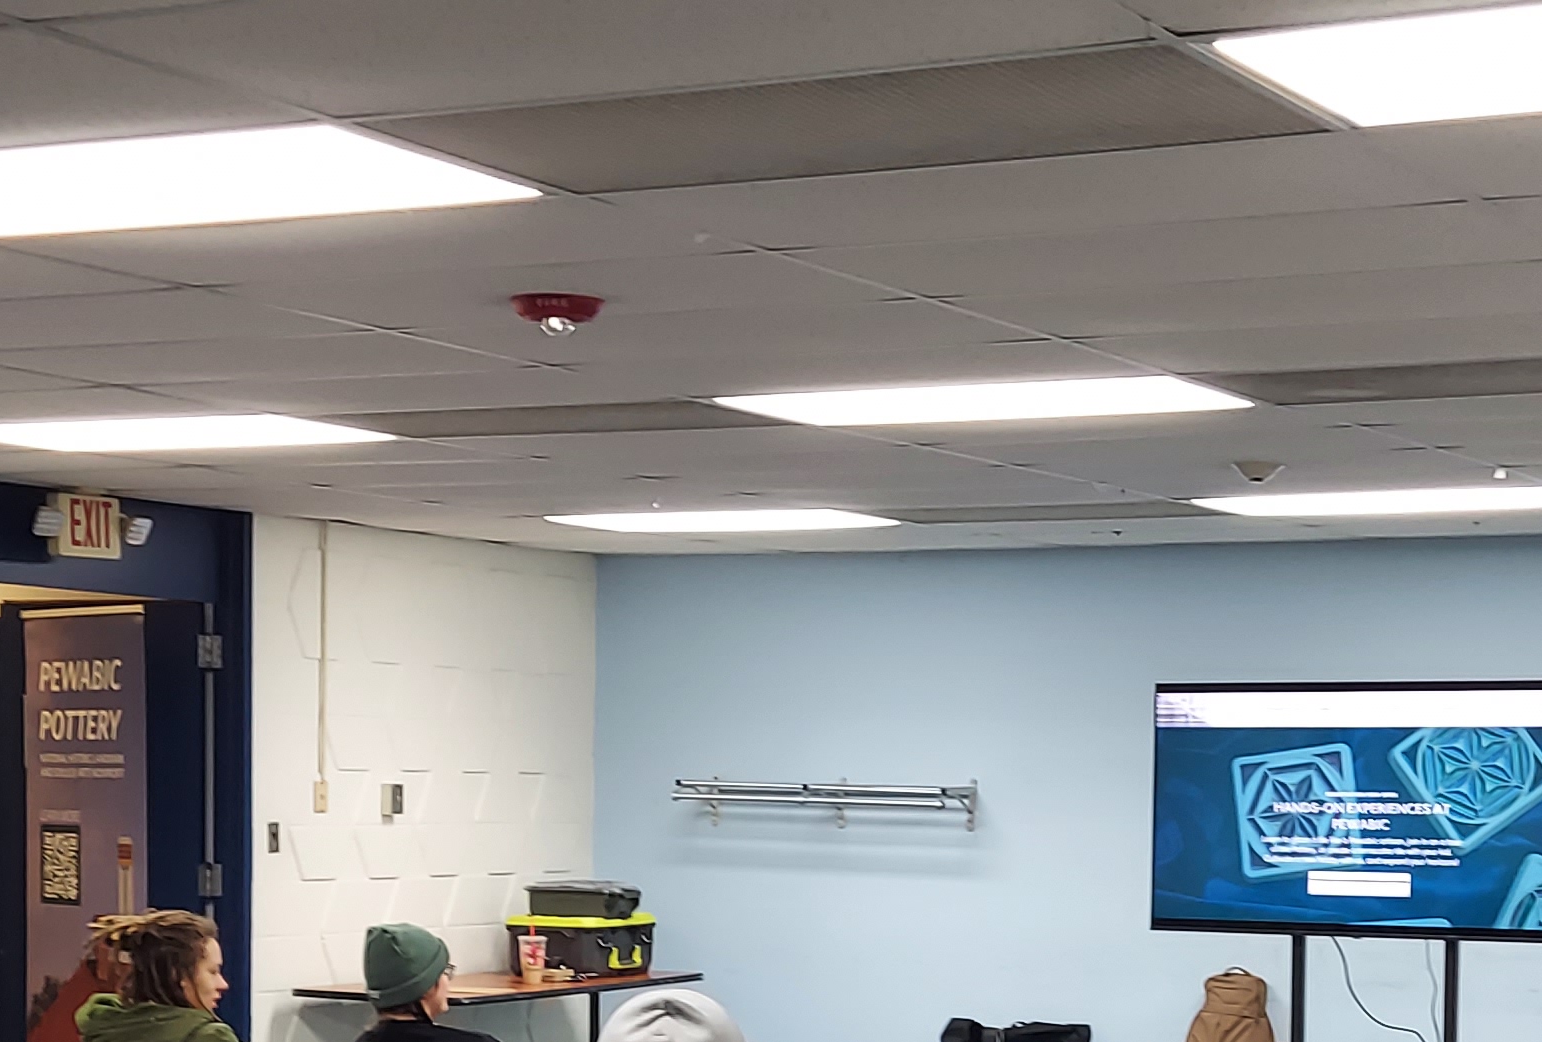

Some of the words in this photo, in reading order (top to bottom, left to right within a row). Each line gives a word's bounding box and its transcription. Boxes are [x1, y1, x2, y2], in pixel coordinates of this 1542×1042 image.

[69, 498, 112, 549] EXIT
[39, 659, 123, 692] PEWABIC
[39, 709, 122, 740] POTTERY
[1272, 801, 1345, 814] HANDS-ON
[1346, 803, 1432, 815] EXPERIENCES
[1433, 803, 1451, 815] AT
